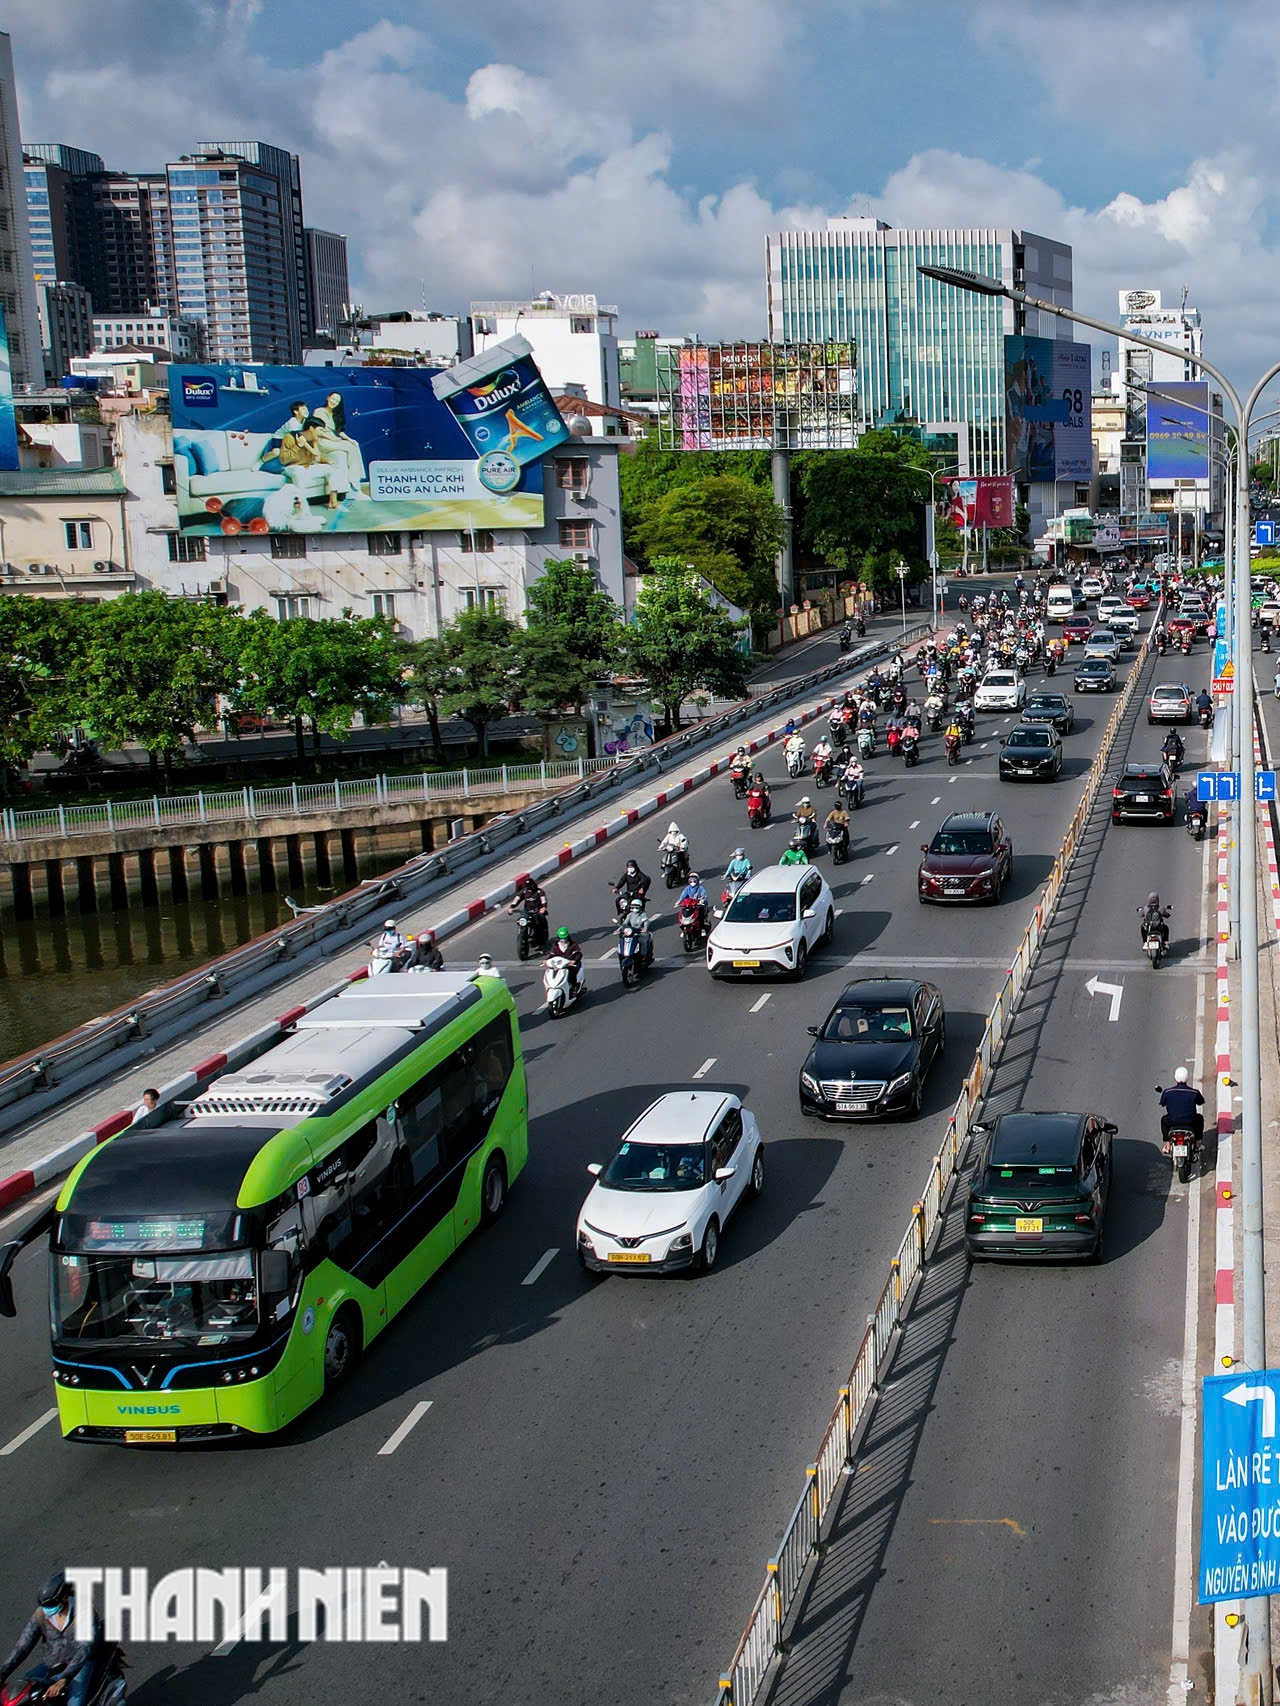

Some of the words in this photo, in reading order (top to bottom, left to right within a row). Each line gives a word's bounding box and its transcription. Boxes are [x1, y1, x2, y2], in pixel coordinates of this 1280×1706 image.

[1144, 331, 1181, 339] VNPT
[185, 387, 211, 396] Dulux
[473, 381, 519, 411] Dulux
[378, 475, 417, 484] THANH
[414, 485, 431, 494] AN
[316, 1158, 342, 1183] VINBUS
[117, 1404, 181, 1415] VINBUS
[1216, 1448, 1248, 1491] LÀN
[1252, 1445, 1272, 1485] RẼ
[1216, 1504, 1248, 1545] VÀO
[1204, 1553, 1250, 1596] NGUYỄN
[1251, 1549, 1275, 1591] BỈNH
